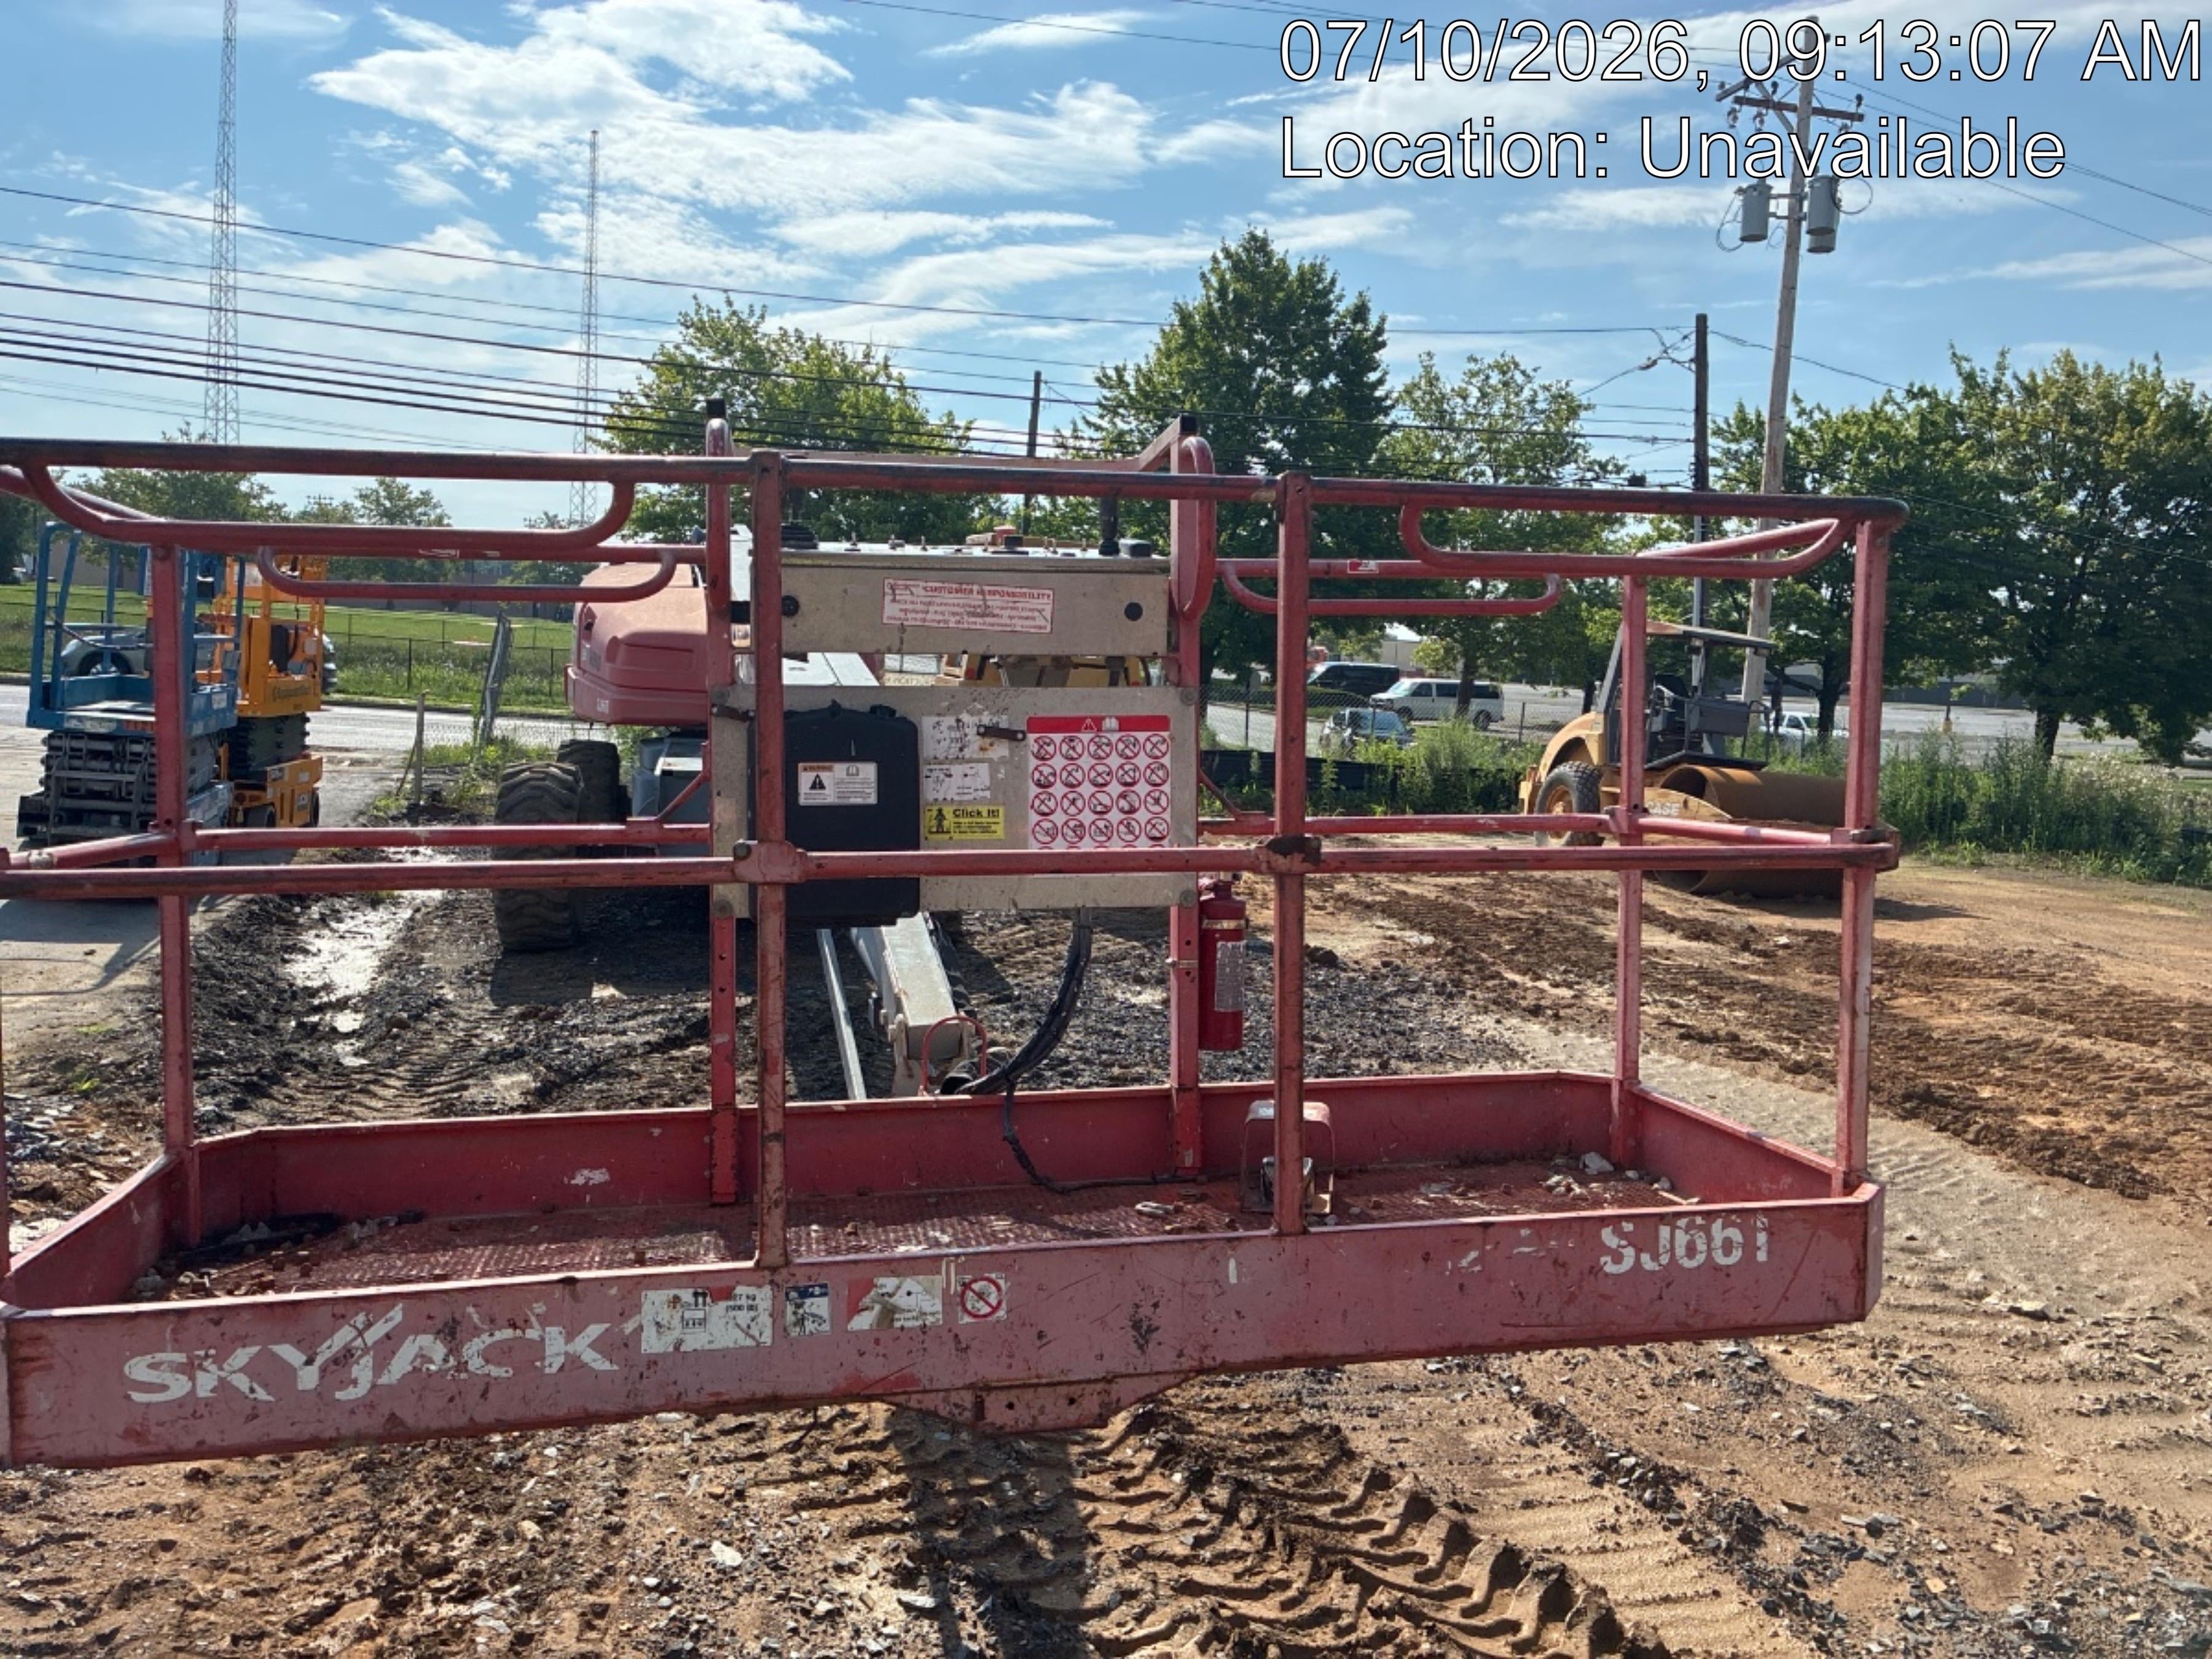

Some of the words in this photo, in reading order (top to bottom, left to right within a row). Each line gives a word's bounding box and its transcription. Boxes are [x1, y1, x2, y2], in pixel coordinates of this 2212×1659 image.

[953, 808, 983, 818] Click
[1646, 801, 1681, 816] CASE
[124, 1303, 620, 1403] SKYJACK
